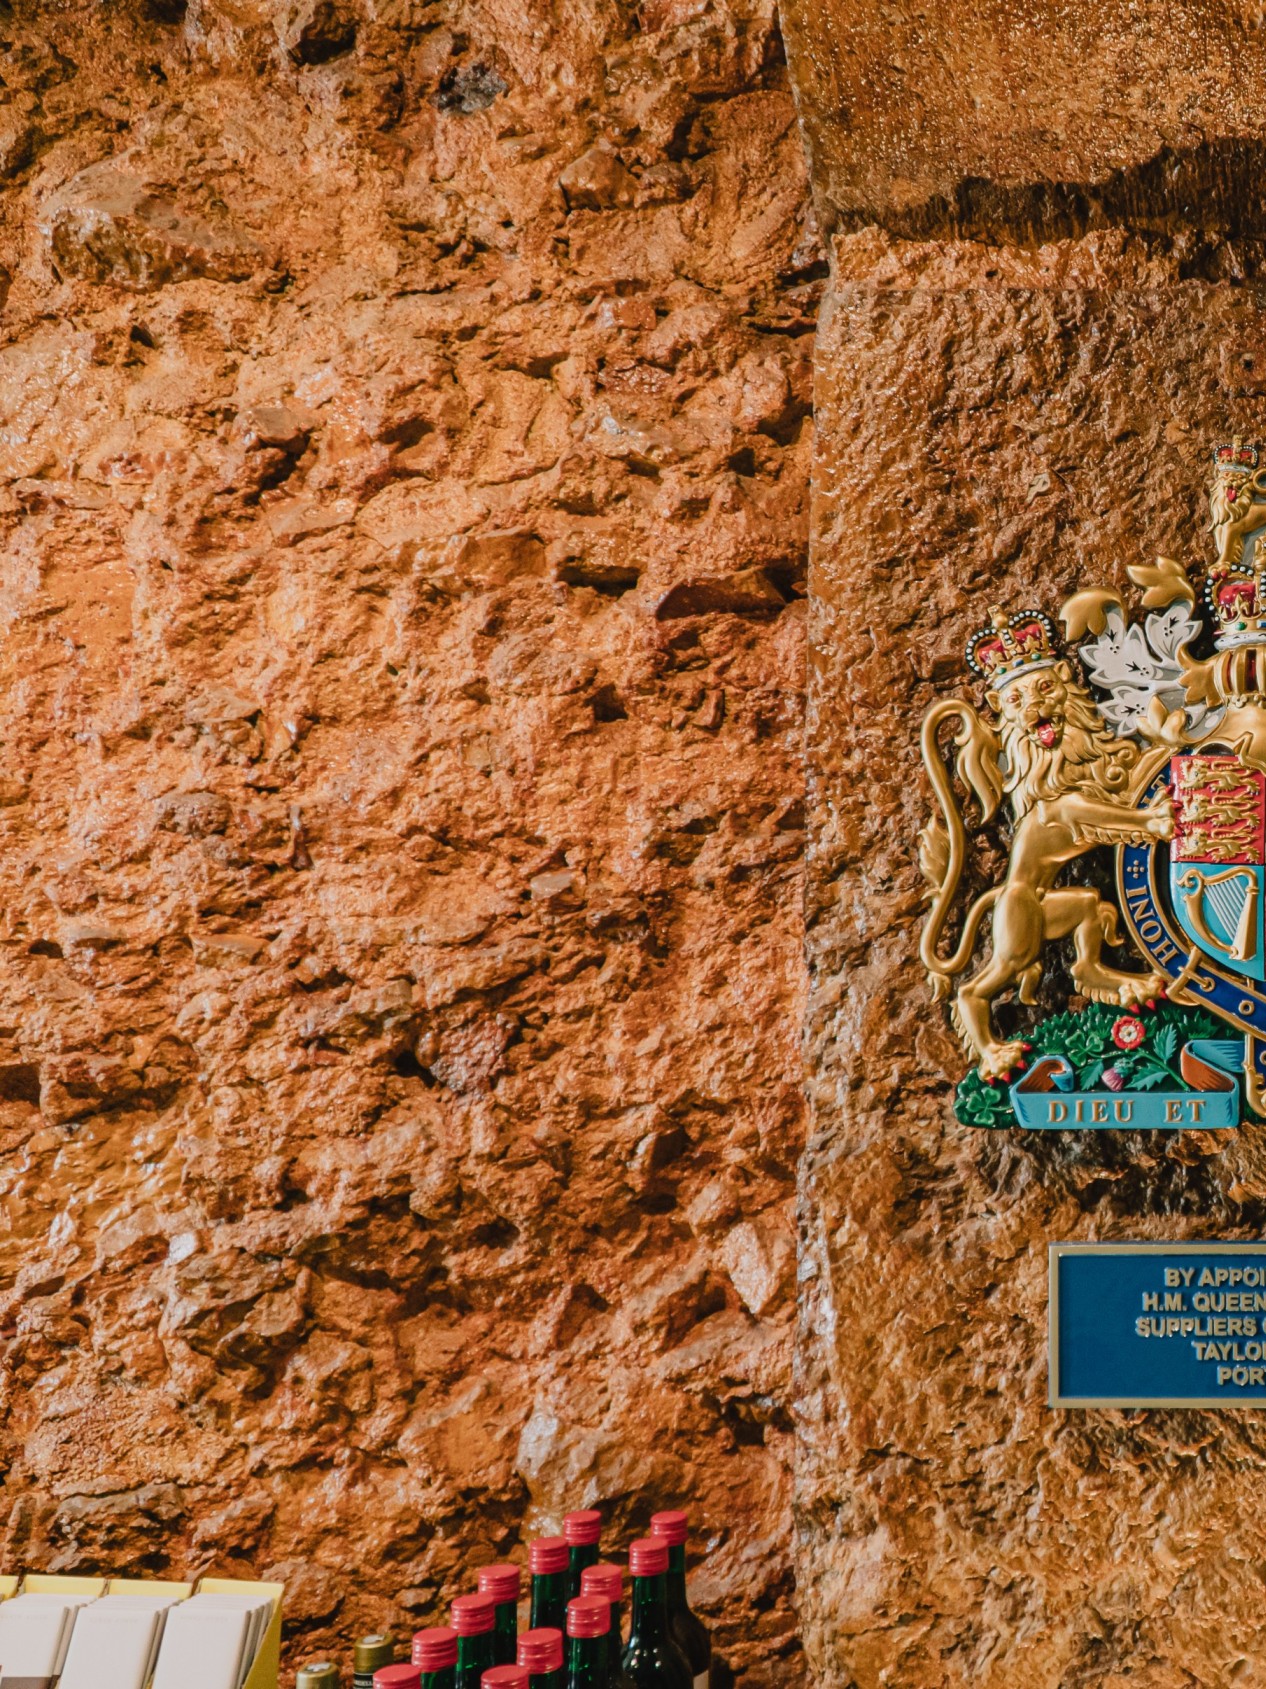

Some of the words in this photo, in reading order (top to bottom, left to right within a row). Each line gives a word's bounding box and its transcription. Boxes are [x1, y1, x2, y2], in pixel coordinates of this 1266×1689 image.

[1126, 886, 1179, 967] HONI
[1047, 1099, 1136, 1124] DIEU
[1164, 1099, 1208, 1124] ET
[1164, 1267, 1195, 1288] BY
[1142, 1292, 1188, 1312] H.M.
[1135, 1316, 1258, 1338] SUPPLIERS
